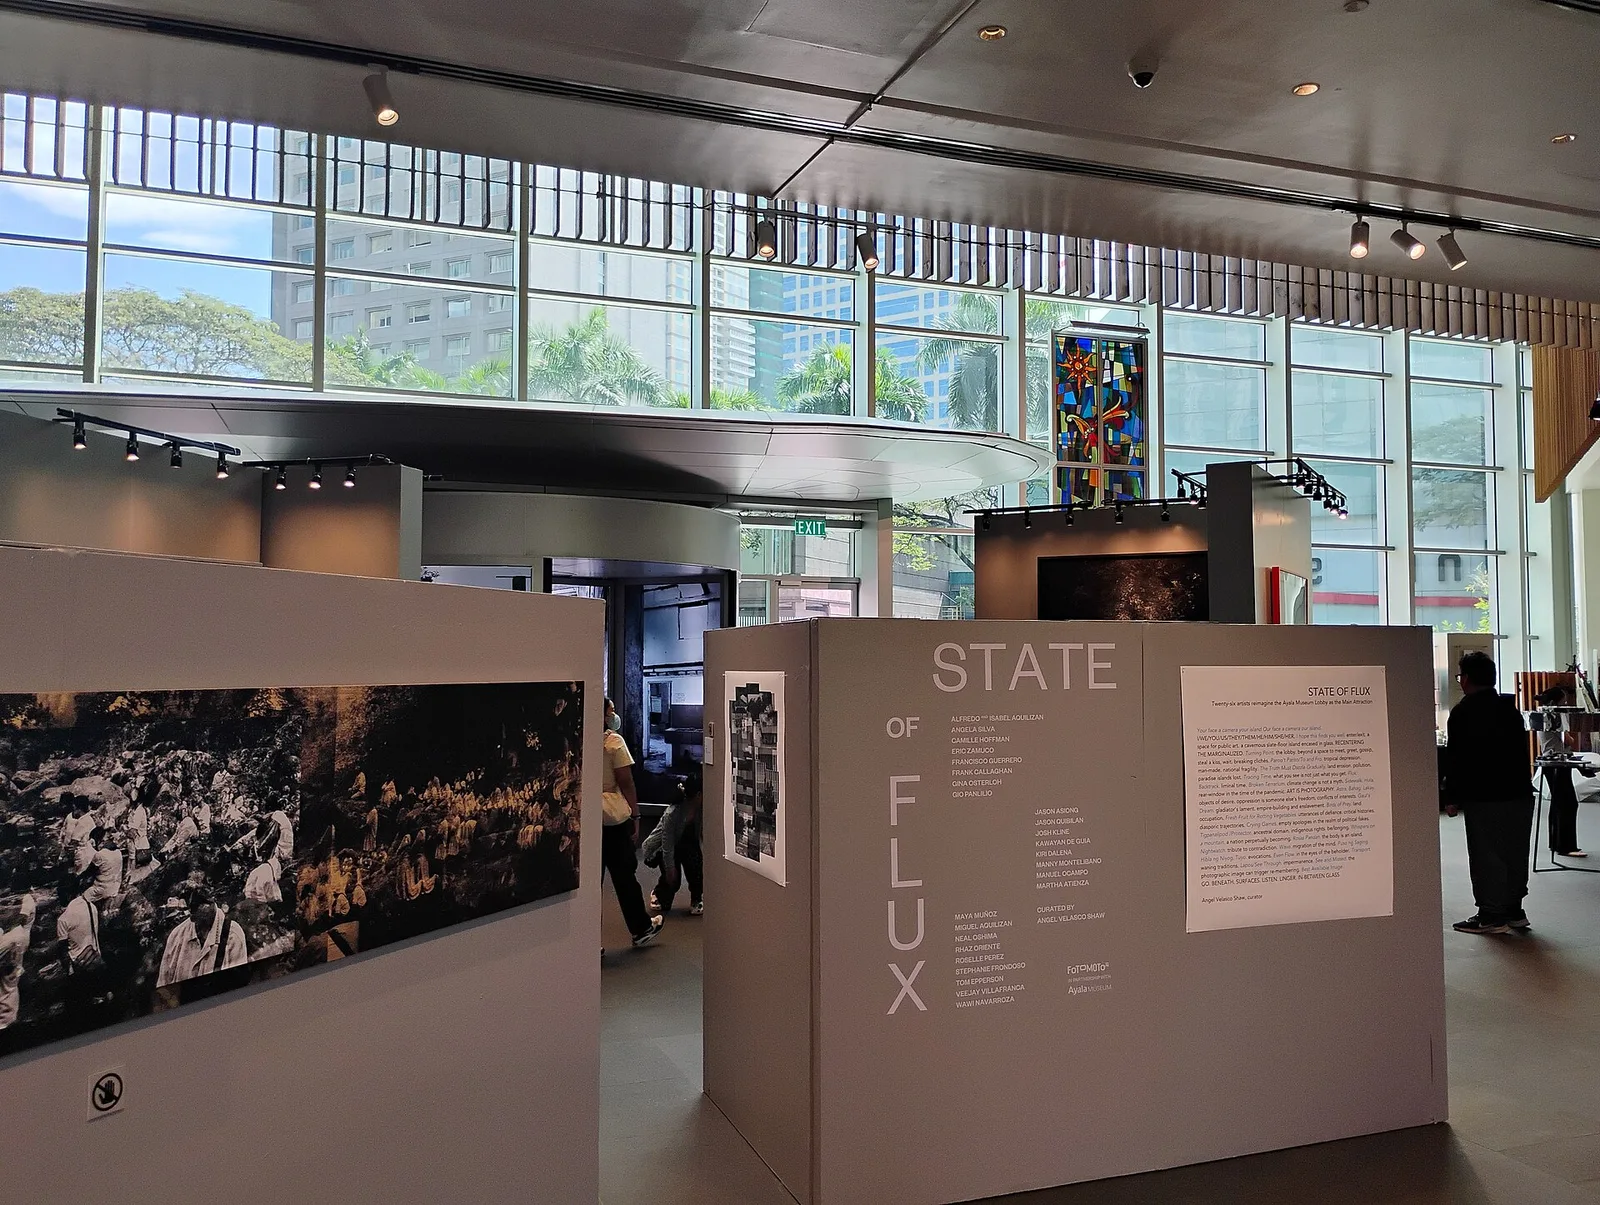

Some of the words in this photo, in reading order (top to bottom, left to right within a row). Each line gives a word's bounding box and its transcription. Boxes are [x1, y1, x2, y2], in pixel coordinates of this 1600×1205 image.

[798, 521, 822, 534] EXIT
[932, 642, 1117, 693] STATE
[1308, 687, 1336, 697] STATE
[1335, 687, 1350, 696] OF
[1349, 686, 1371, 696] FLUX
[886, 716, 920, 739] OF
[974, 910, 997, 918] MUÑOZ
[1037, 905, 1066, 913] CURATED
[955, 966, 990, 974] STEPHANIE
[991, 963, 1026, 971] FRONDOSO
[971, 976, 1004, 984] EPPERSON
[956, 989, 980, 997] VEEJAY
[981, 985, 1025, 994] VILLAFRANCA
[1068, 985, 1088, 996] Ayala
[975, 997, 1015, 1005] NAVARROZA
